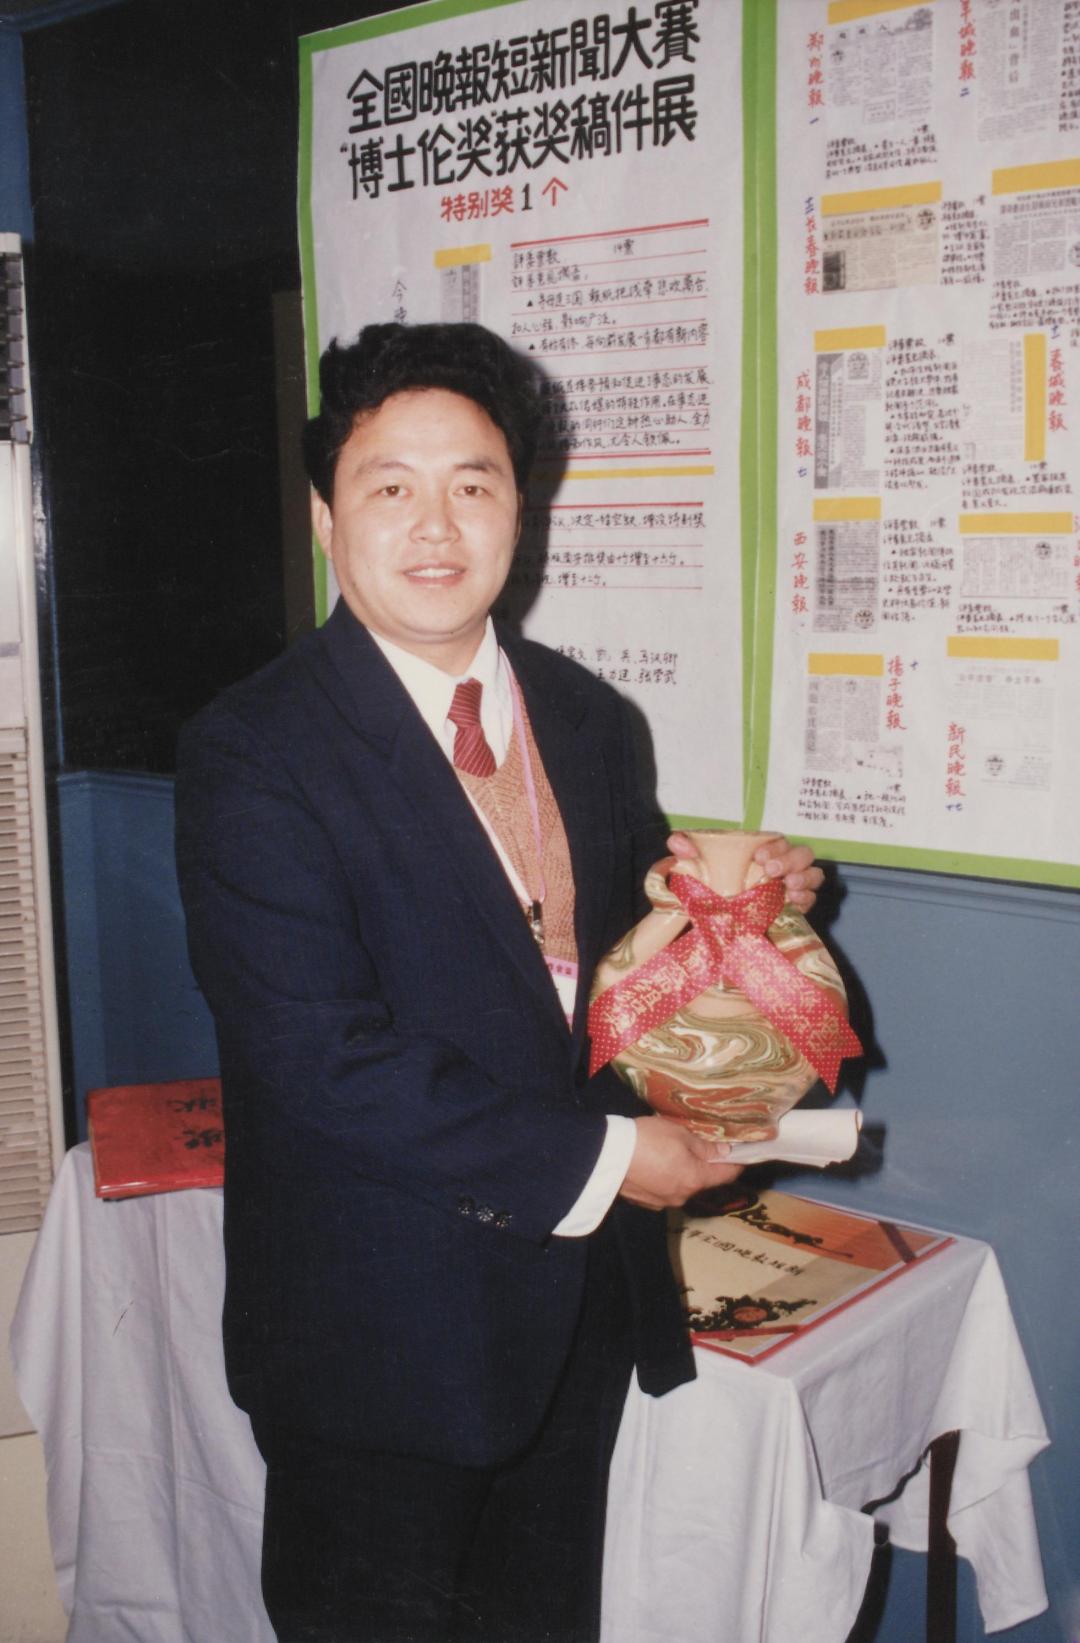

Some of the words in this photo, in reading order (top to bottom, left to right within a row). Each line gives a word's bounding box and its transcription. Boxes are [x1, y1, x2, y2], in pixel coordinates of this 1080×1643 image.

[347, 0, 700, 133] 全國晚報短新聞大賽
